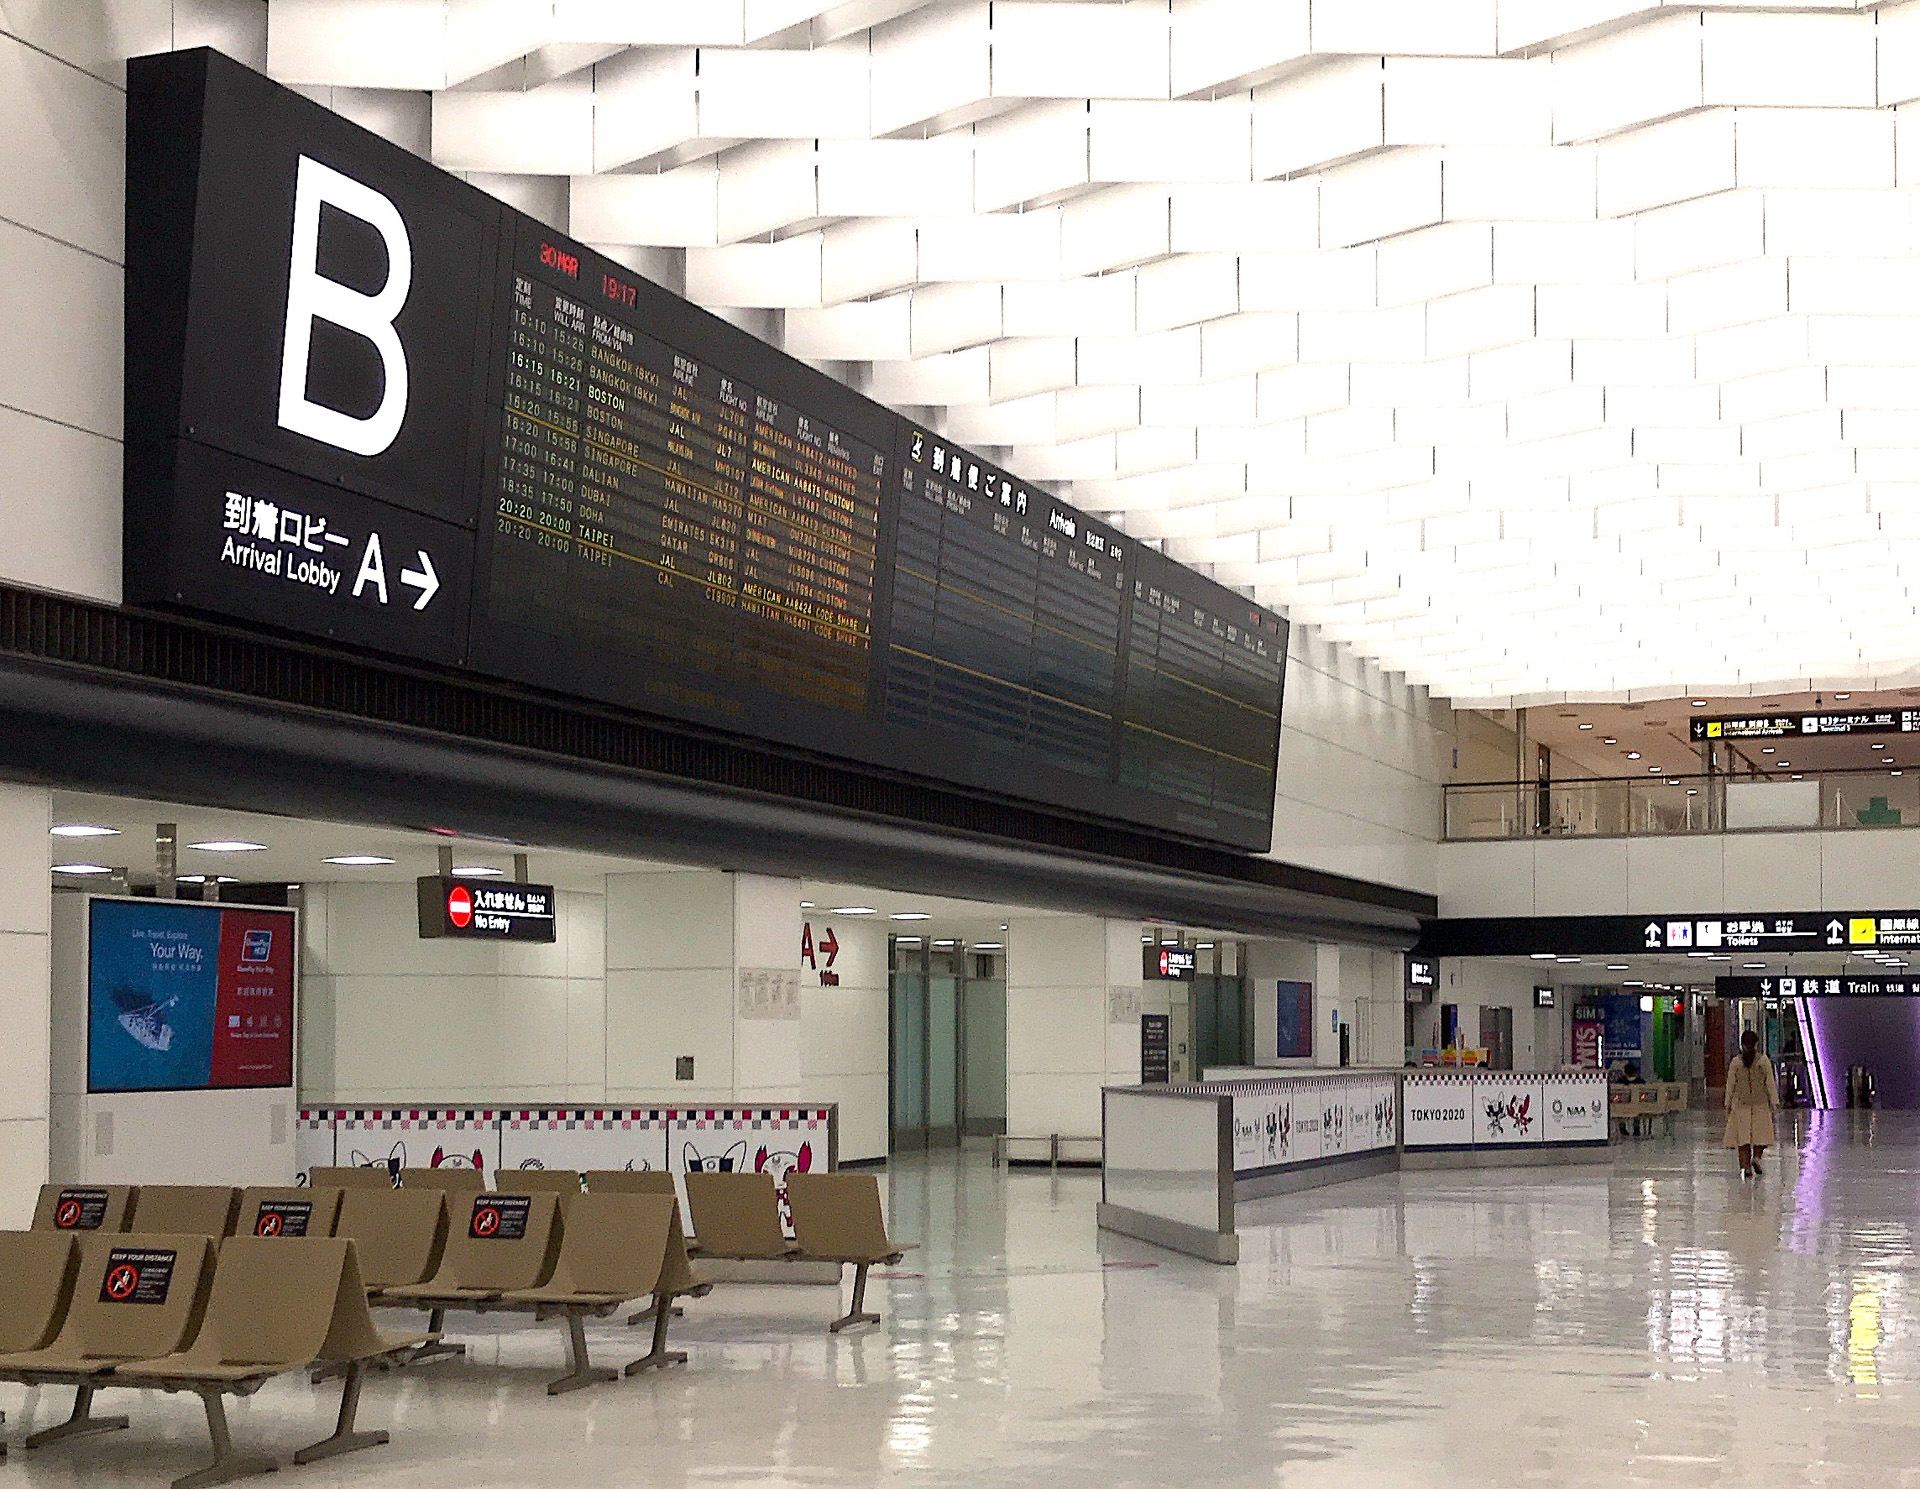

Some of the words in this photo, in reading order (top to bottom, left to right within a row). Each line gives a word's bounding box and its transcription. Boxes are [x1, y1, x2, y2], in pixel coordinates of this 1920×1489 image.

[278, 153, 414, 457] B
[602, 274, 638, 307] 19:17
[512, 329, 545, 355] 16:10
[590, 364, 631, 394] BANGKOK
[514, 308, 546, 335] 16:10
[591, 344, 632, 375] BANGKOK
[672, 383, 687, 401] JAL
[509, 371, 542, 396] 16:15
[587, 404, 623, 431] BOSTON
[510, 350, 543, 377] 16:15
[550, 368, 581, 393] 16:21
[588, 385, 624, 412] BOSTON
[669, 421, 685, 439] JAL
[716, 442, 731, 459] JL7
[752, 457, 790, 484] AMERICAN
[824, 489, 854, 513] CUSTOMS
[506, 414, 538, 438] 16:20
[584, 445, 637, 477] SINGAPORE
[664, 477, 708, 505] HAWAIIAN
[507, 392, 540, 417] 16:20
[585, 425, 638, 457] SINGAPORE
[666, 458, 682, 475] JAL
[502, 456, 535, 479] 17:35
[543, 471, 574, 493] 17:00
[580, 485, 610, 506] DUBAI
[662, 514, 704, 542] EMIRATES
[504, 434, 537, 458] 17:00
[544, 450, 575, 473] 16:41
[582, 464, 618, 489] DALIAN
[663, 495, 679, 512] JAL
[931, 445, 1028, 516] 到着便ご案内
[222, 491, 350, 553] 到着ロビー
[498, 518, 531, 540] 20:20
[538, 531, 569, 553] 20:00
[577, 544, 612, 567] TAIPEI
[501, 476, 534, 499] 18:35
[541, 491, 572, 513] 17:50
[579, 504, 604, 524] DOHA
[660, 533, 688, 554] QATAR
[744, 563, 758, 579] JAL
[220, 536, 282, 577] Arrival
[286, 549, 341, 596] Lobby
[352, 531, 388, 605] A
[499, 497, 532, 520] 20:20
[539, 511, 571, 533] 20:00
[579, 524, 613, 548] TAIPEI
[659, 552, 675, 569] JAL
[707, 569, 732, 588] JL802
[742, 581, 780, 605] AMERICAN
[815, 606, 833, 622] CODE
[474, 889, 526, 911] 入れません
[474, 914, 488, 930] No
[488, 915, 511, 934] Entry
[150, 943, 175, 960] Your
[801, 921, 817, 971] A
[1726, 935, 1759, 947] Toilets
[1576, 1006, 1596, 1020] SIM
[1803, 978, 1841, 994] 鉄道
[1847, 981, 1880, 994] Train
[1411, 1108, 1441, 1121] TOKYO
[1442, 1108, 1465, 1120] 2020
